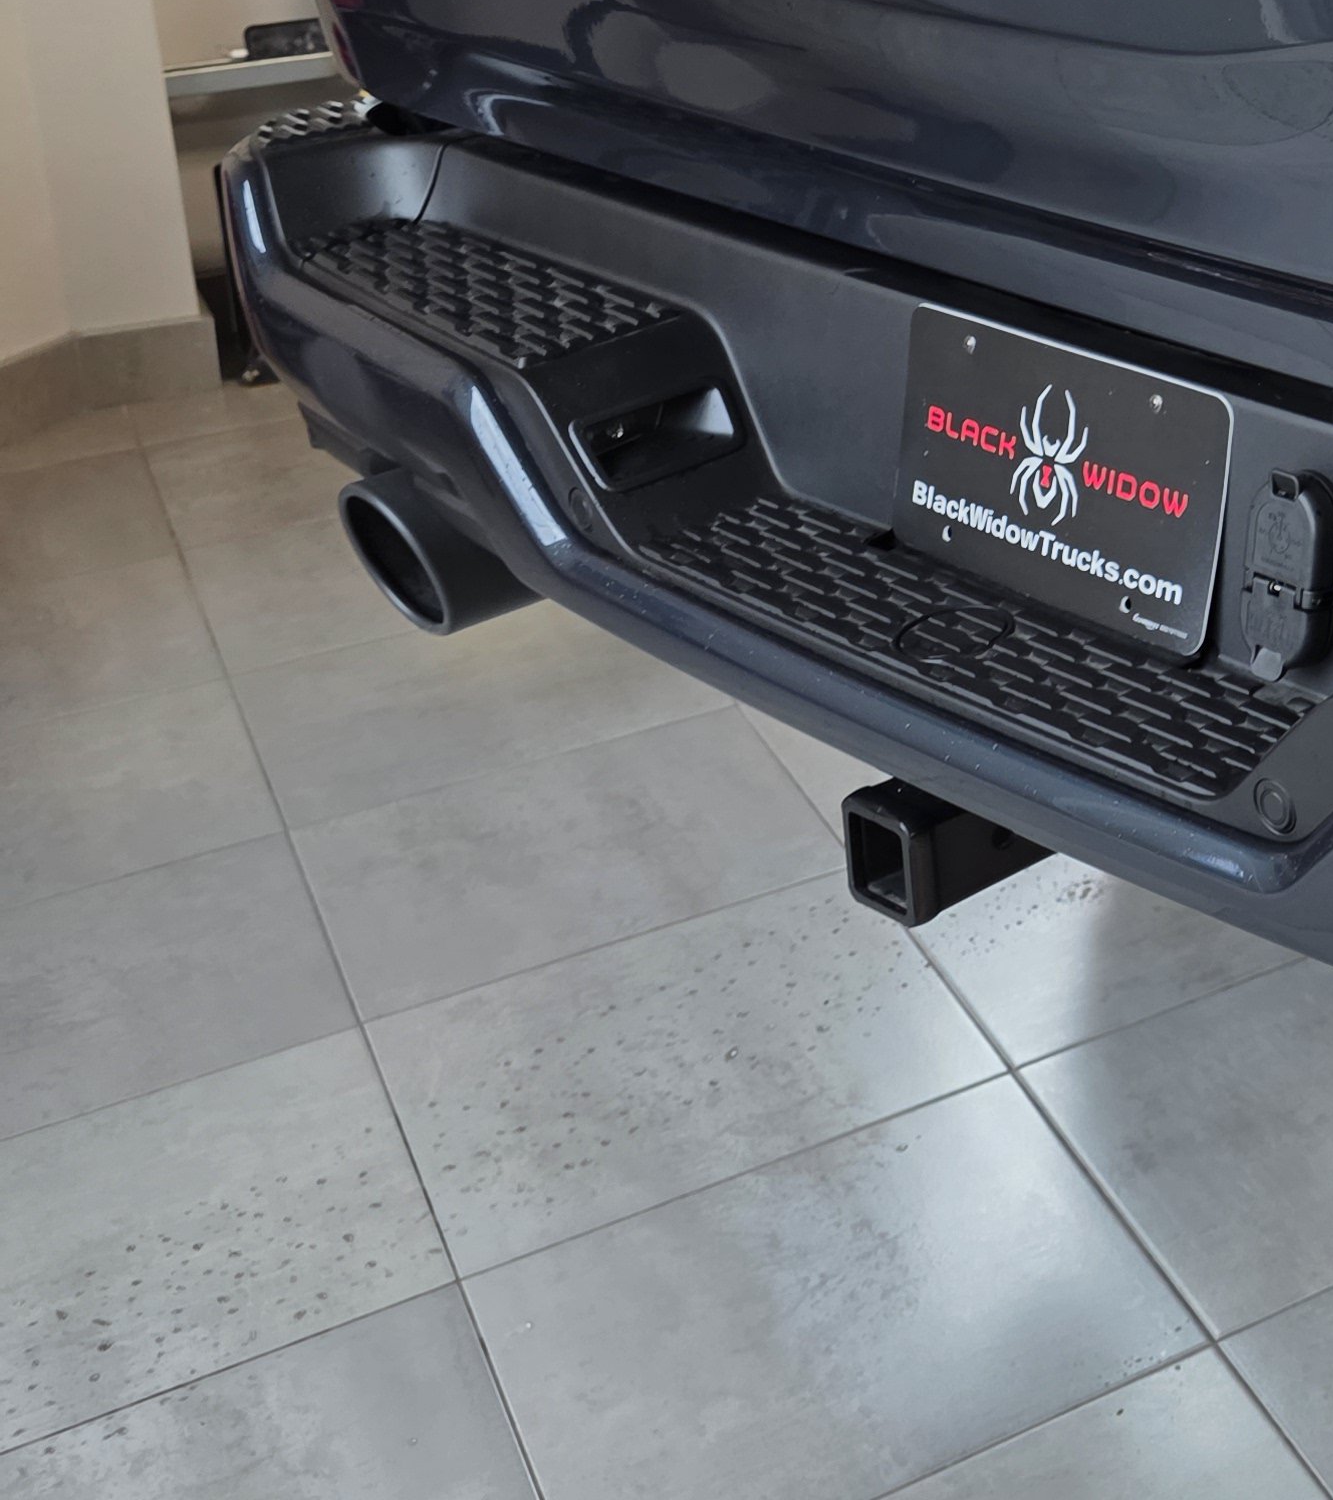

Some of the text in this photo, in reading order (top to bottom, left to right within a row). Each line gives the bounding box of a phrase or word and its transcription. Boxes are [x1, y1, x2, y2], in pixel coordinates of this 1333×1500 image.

[926, 405, 1189, 518] BLACK WIDOW
[911, 479, 1183, 605] BlackWidowTrucks.com
